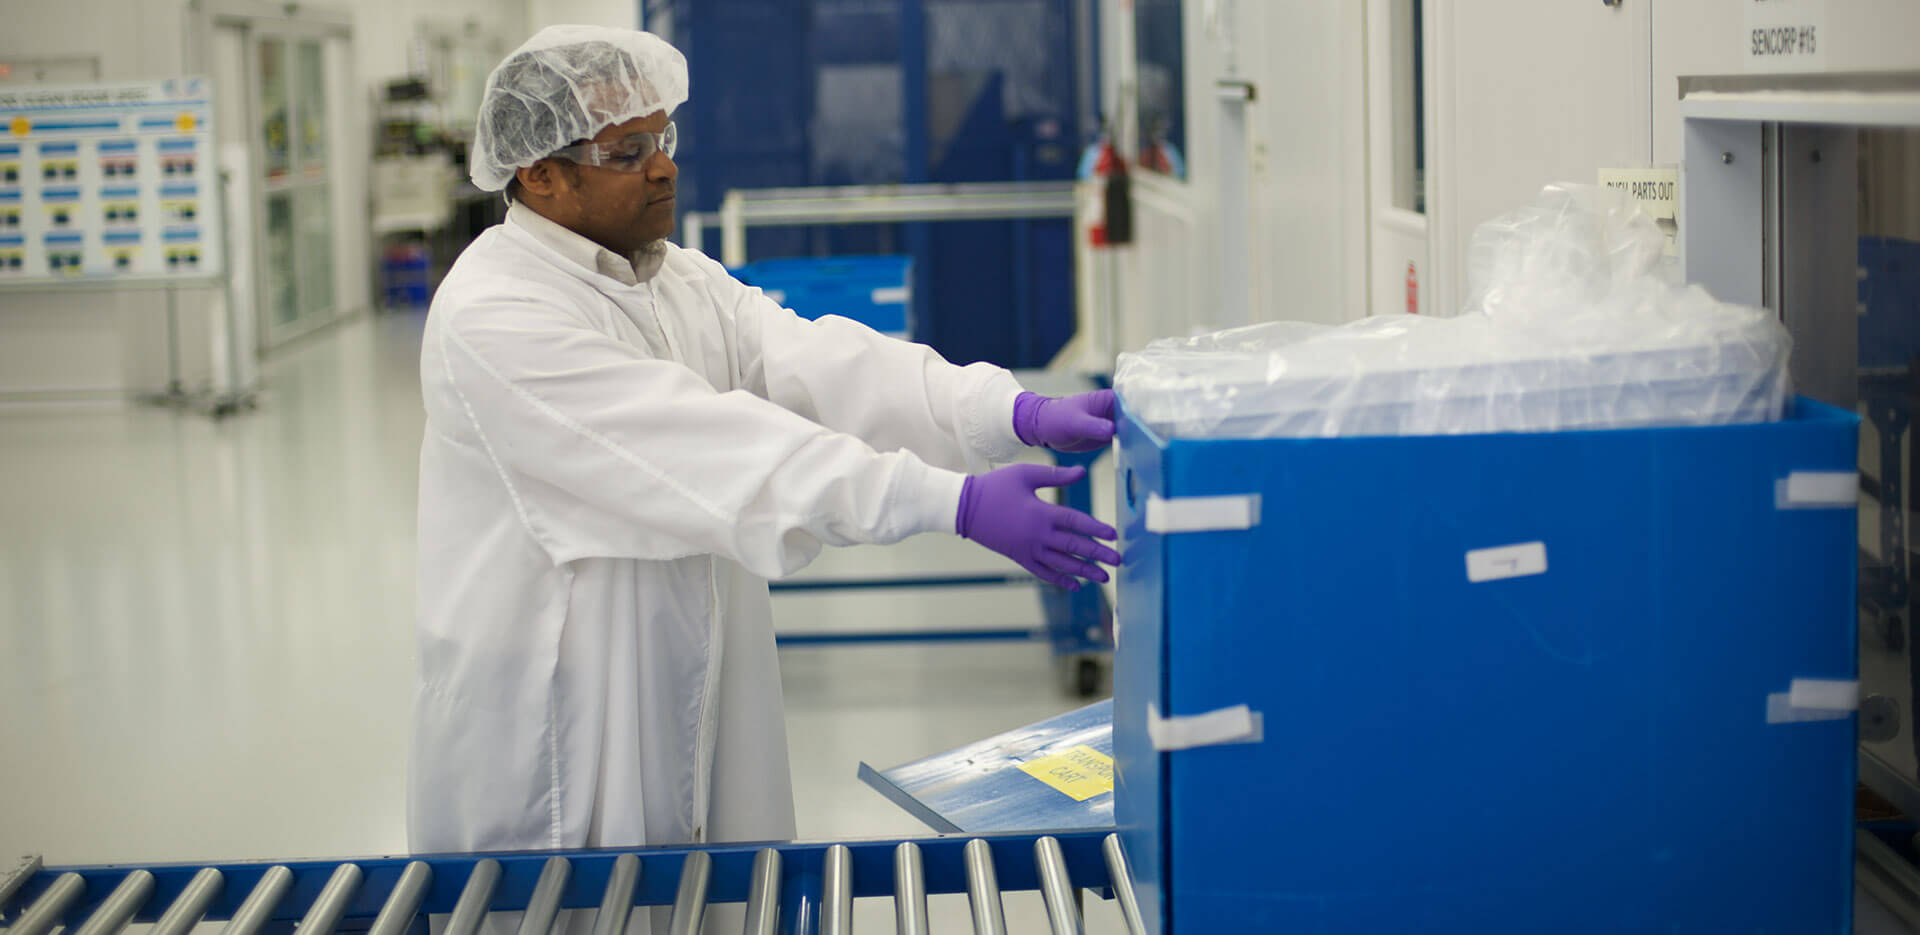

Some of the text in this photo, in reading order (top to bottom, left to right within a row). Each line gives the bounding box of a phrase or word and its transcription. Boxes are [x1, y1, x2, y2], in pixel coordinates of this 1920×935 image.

[1752, 25, 1816, 56] SENCORP #15
[1632, 182, 1657, 200] PARTS
[1658, 182, 1674, 200] OUT
[1049, 766, 1087, 783] CART
